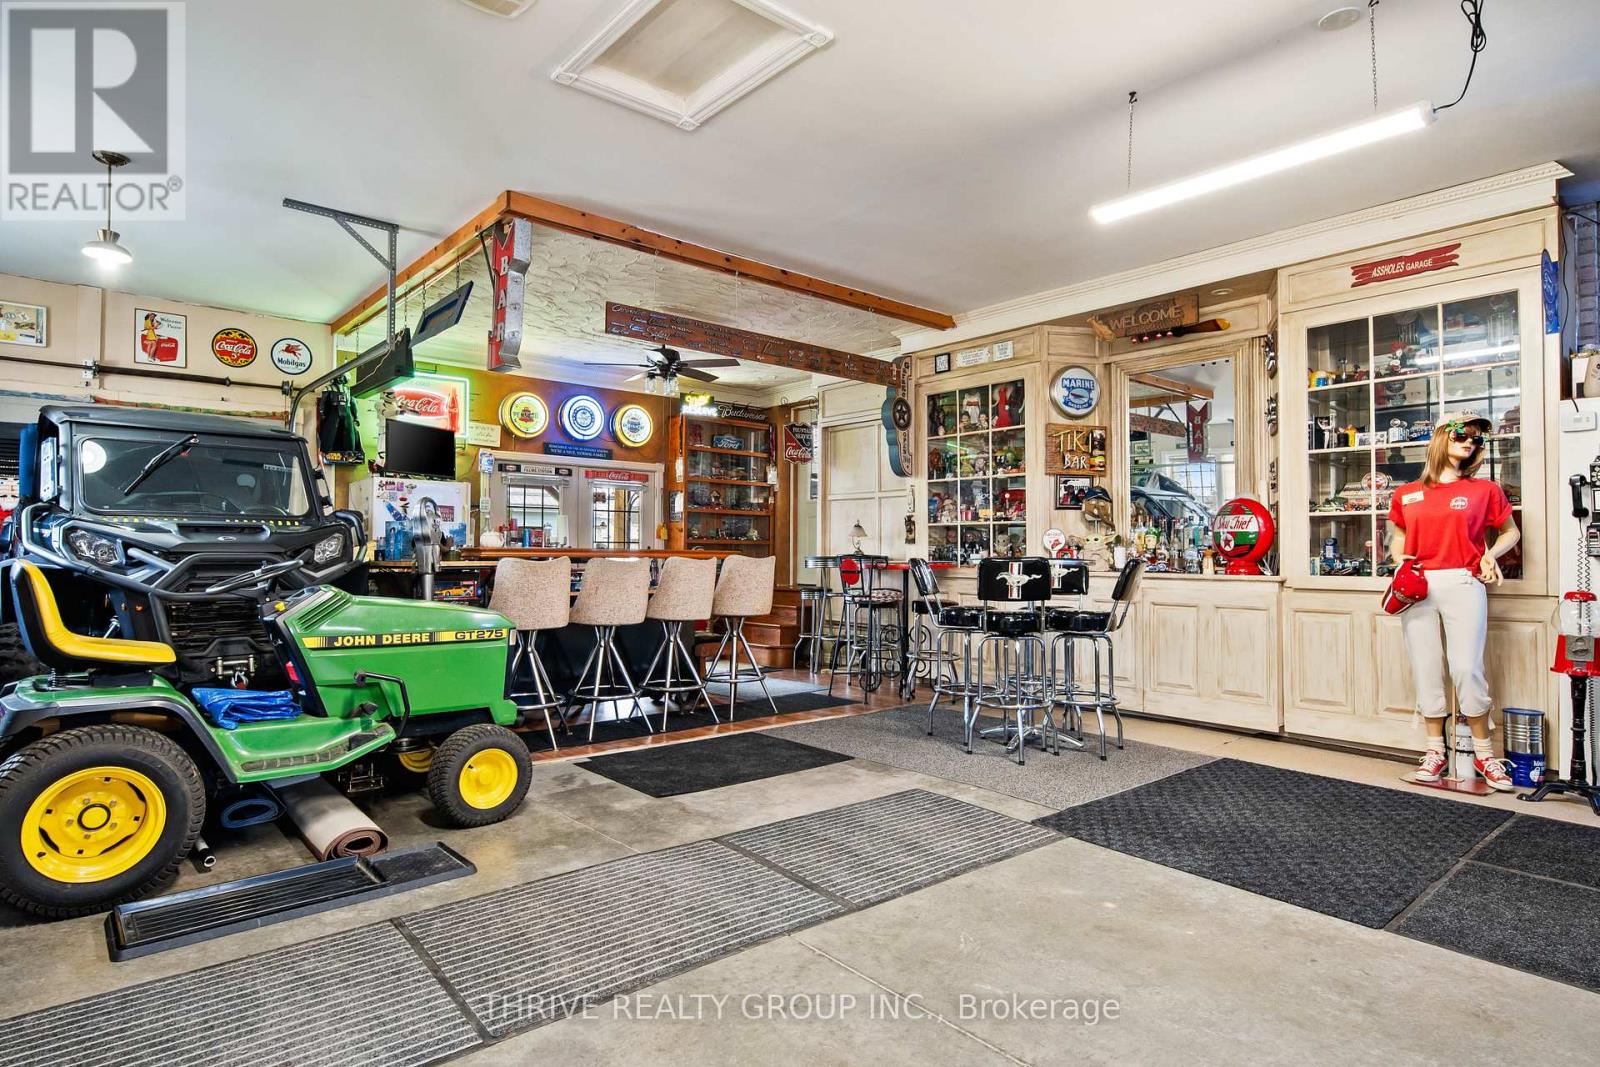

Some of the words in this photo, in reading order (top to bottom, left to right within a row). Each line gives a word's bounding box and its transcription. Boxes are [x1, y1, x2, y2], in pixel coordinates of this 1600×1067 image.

[1371, 261, 1405, 278] ASSHOLES
[1405, 258, 1433, 271] GARAGE
[496, 255, 509, 342] BAR
[1110, 305, 1185, 330] WELCOME
[277, 357, 306, 368] Mobilgas
[1061, 377, 1095, 391] MARINE
[719, 404, 769, 421] Budweiser
[717, 438, 740, 449] Ford
[1048, 429, 1092, 454] TIKI
[1063, 454, 1087, 470] BAR
[1230, 516, 1254, 530] Chief
[334, 635, 376, 647] JOHN
[382, 633, 430, 646] DEERE
